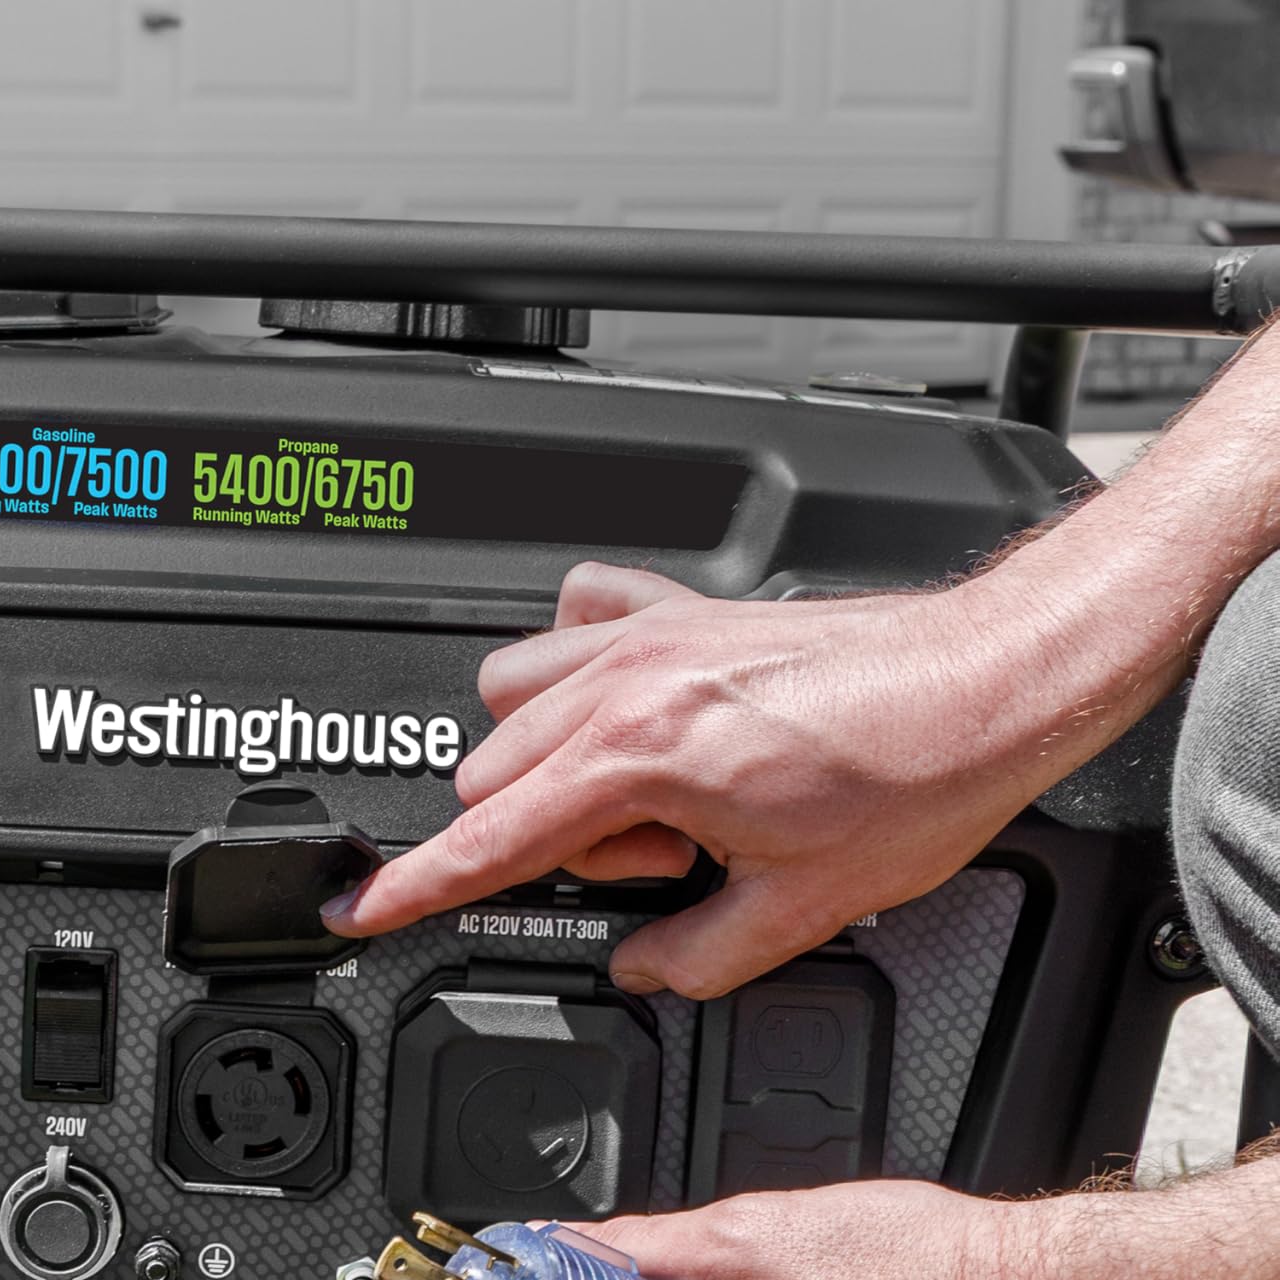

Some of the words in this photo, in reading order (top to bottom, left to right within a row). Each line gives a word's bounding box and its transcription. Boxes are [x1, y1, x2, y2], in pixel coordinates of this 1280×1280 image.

[32, 427, 95, 444] Gasoline
[278, 438, 338, 456] Propane
[193, 452, 414, 516] 5400/6750
[3, 499, 49, 514] Watts
[74, 502, 110, 516] Peak
[112, 504, 157, 518] Watts
[192, 506, 252, 526] Running
[254, 510, 300, 526] Watts
[324, 514, 360, 528] Peak
[362, 515, 407, 530] Watts
[34, 687, 459, 772] Westinghouse
[459, 914, 480, 934] AC
[483, 915, 520, 936] 120V
[54, 930, 94, 948] 120V
[46, 1116, 86, 1136] 240V
